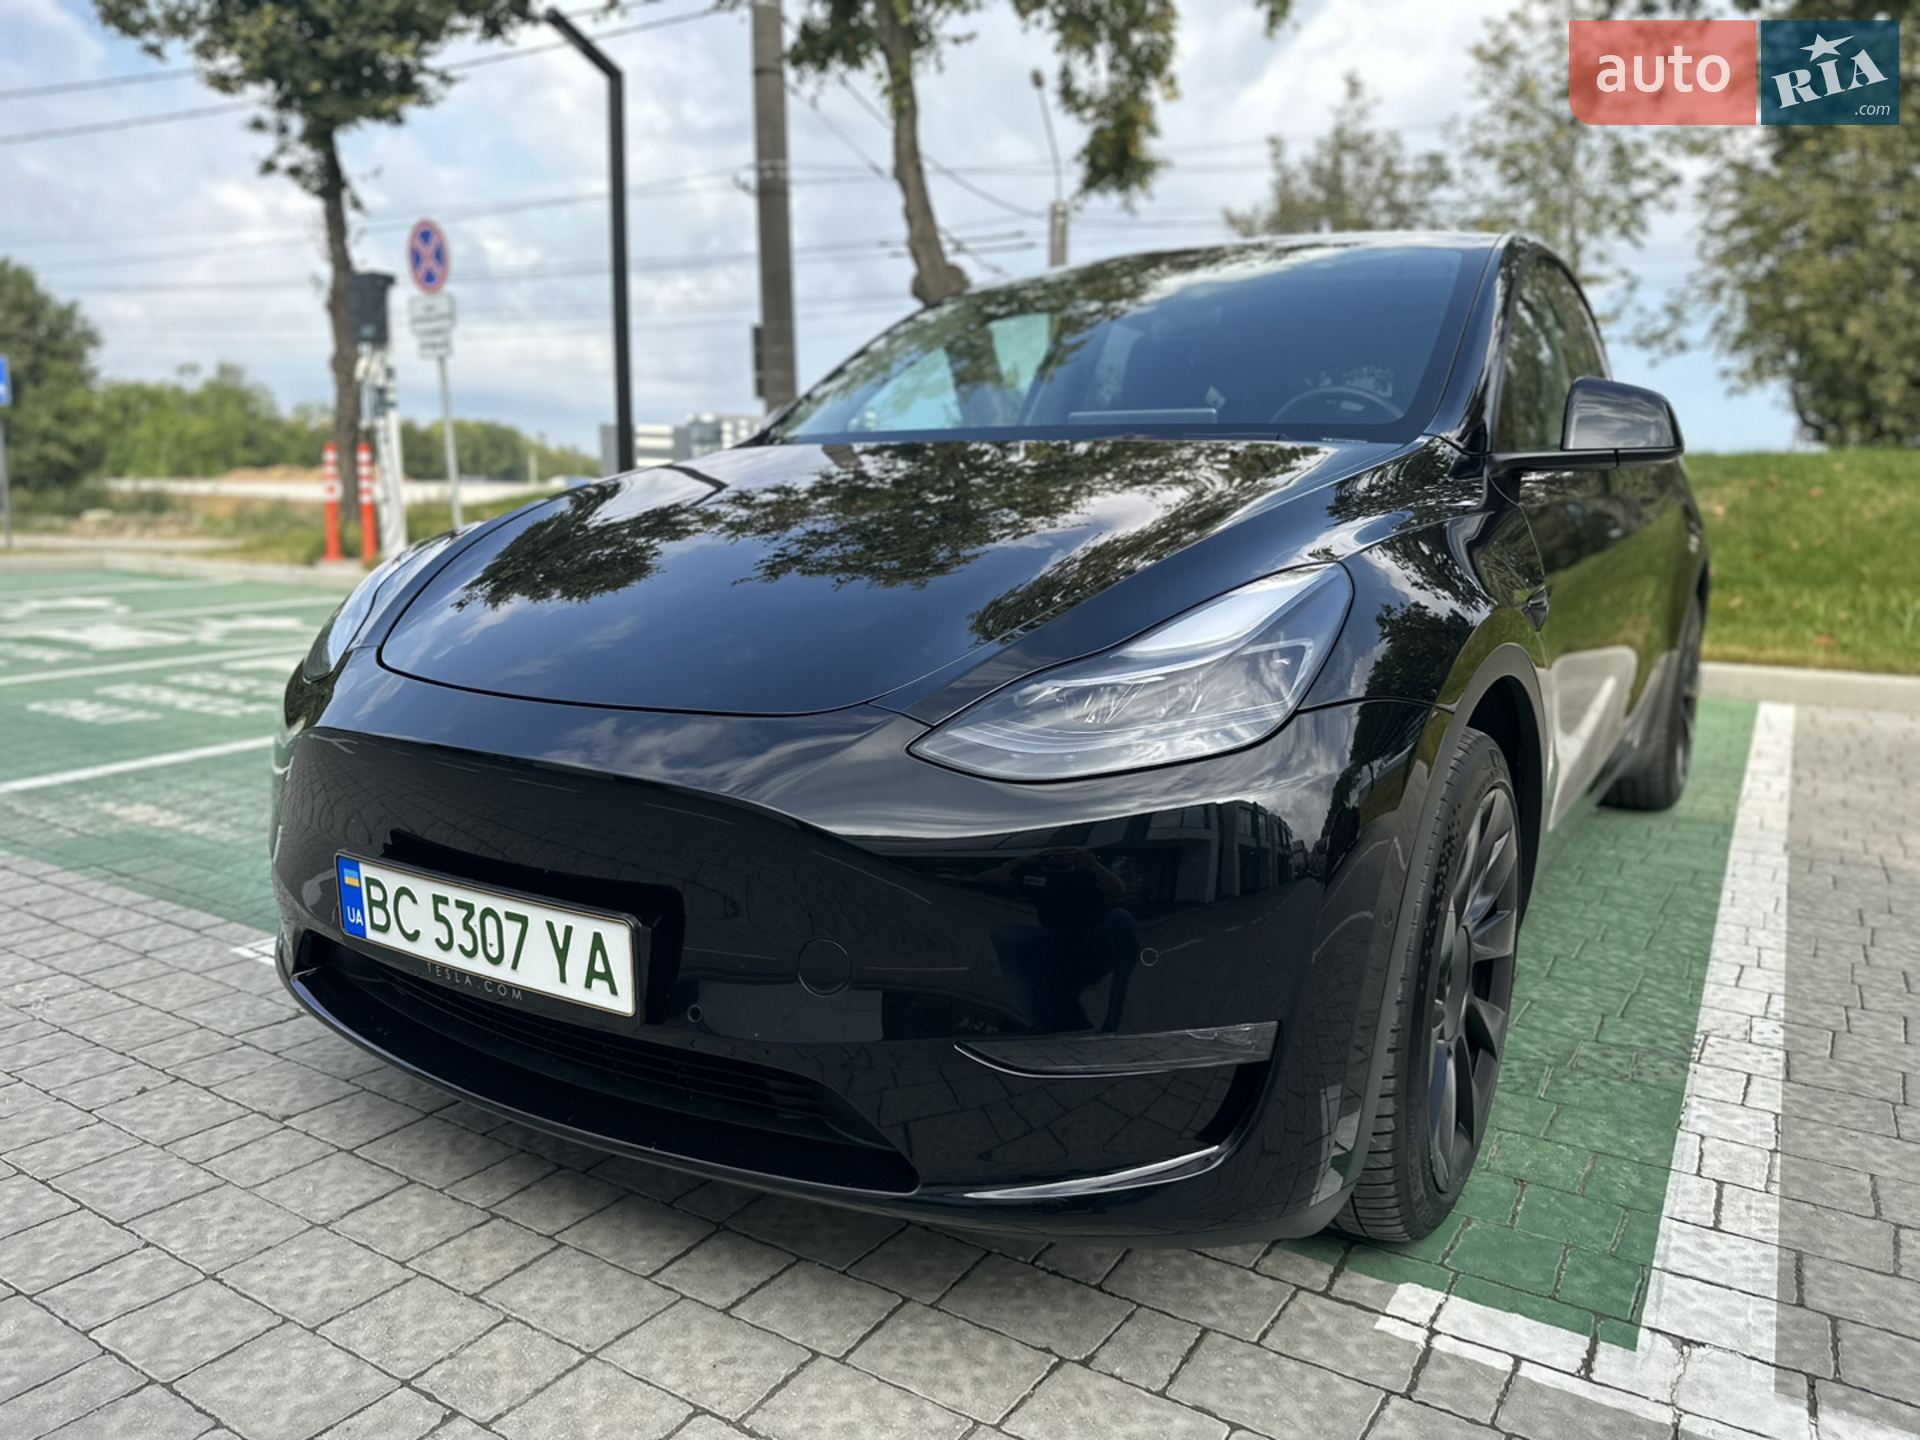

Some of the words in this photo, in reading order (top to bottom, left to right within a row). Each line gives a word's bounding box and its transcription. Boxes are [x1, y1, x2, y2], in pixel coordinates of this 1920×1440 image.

[347, 906, 364, 926] UA
[364, 876, 421, 942] BC
[431, 893, 529, 972] 5307
[545, 920, 619, 996] YA
[426, 962, 523, 1001] TESLA.COM
